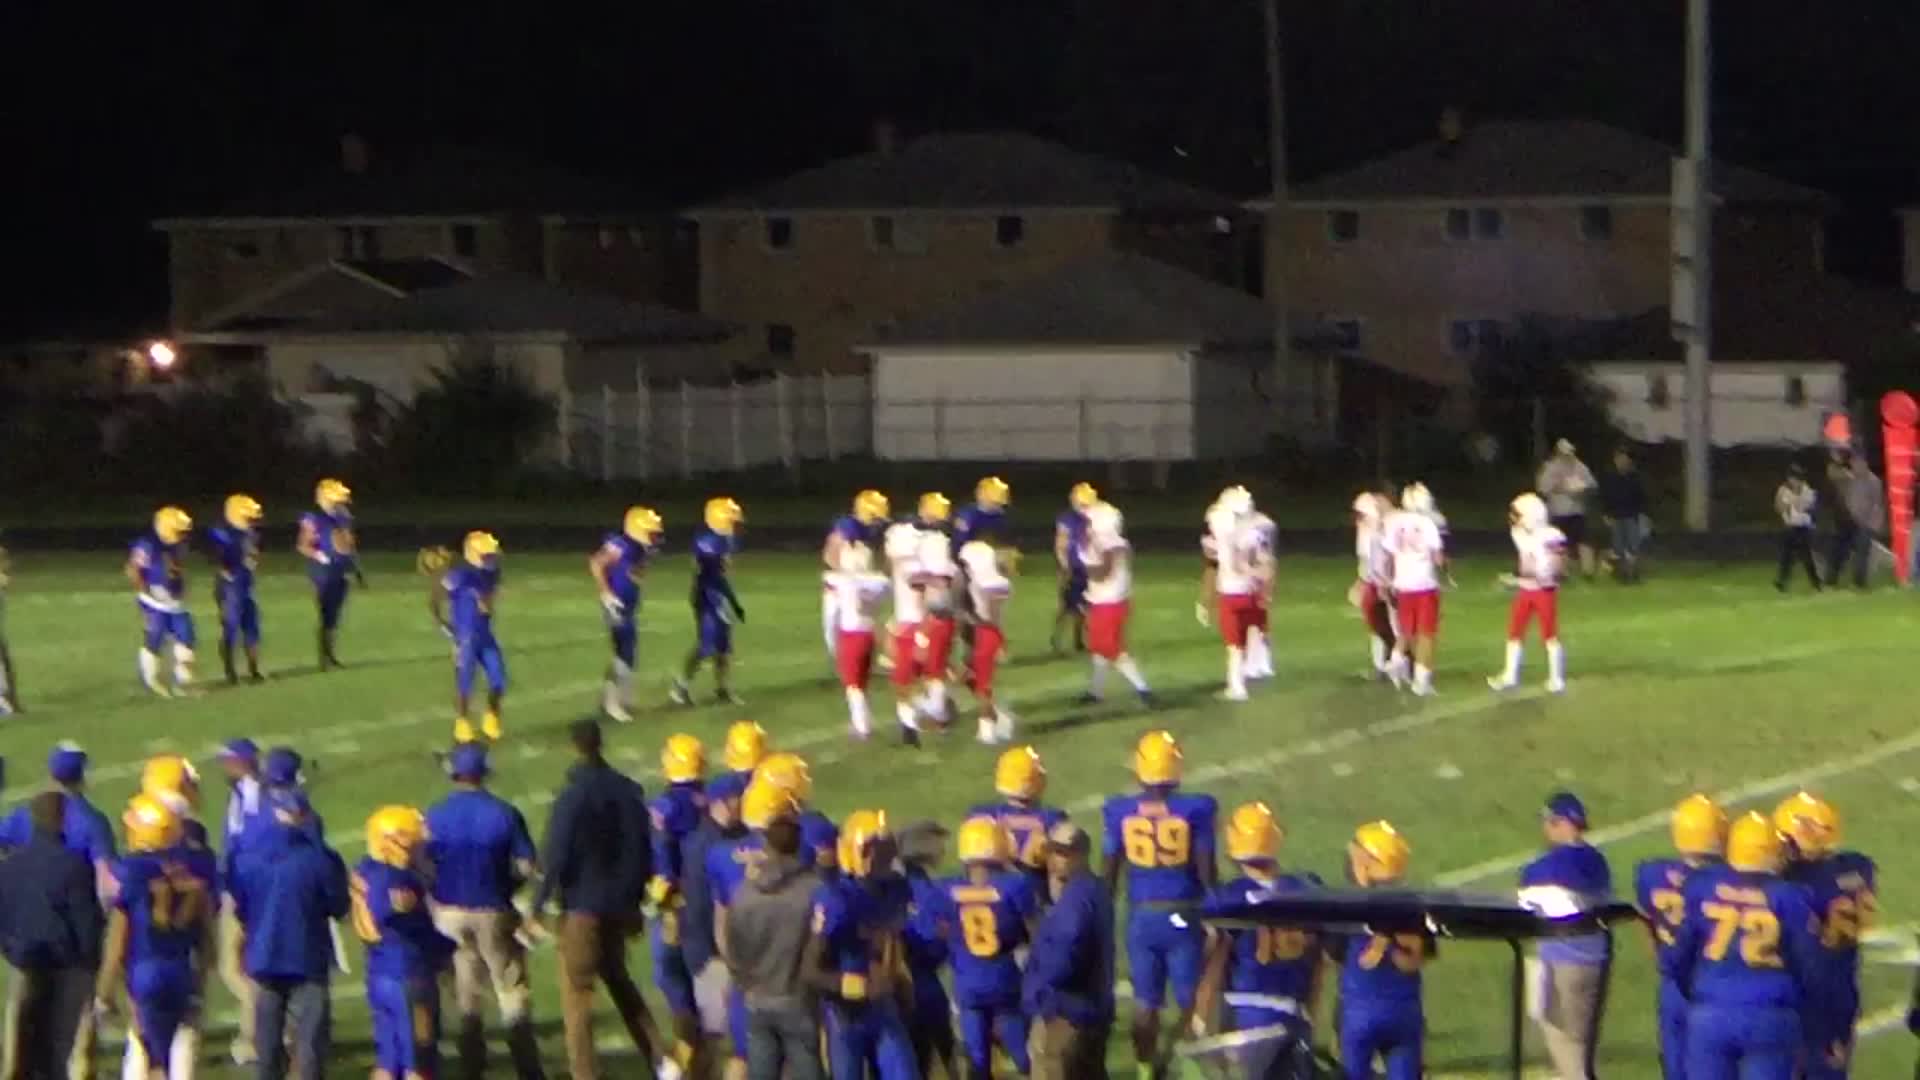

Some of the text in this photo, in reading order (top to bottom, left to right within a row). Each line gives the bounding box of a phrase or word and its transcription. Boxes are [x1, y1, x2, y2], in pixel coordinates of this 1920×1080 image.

[1121, 815, 1190, 868] 69
[960, 903, 999, 957] 8
[1701, 901, 1784, 968] 72
